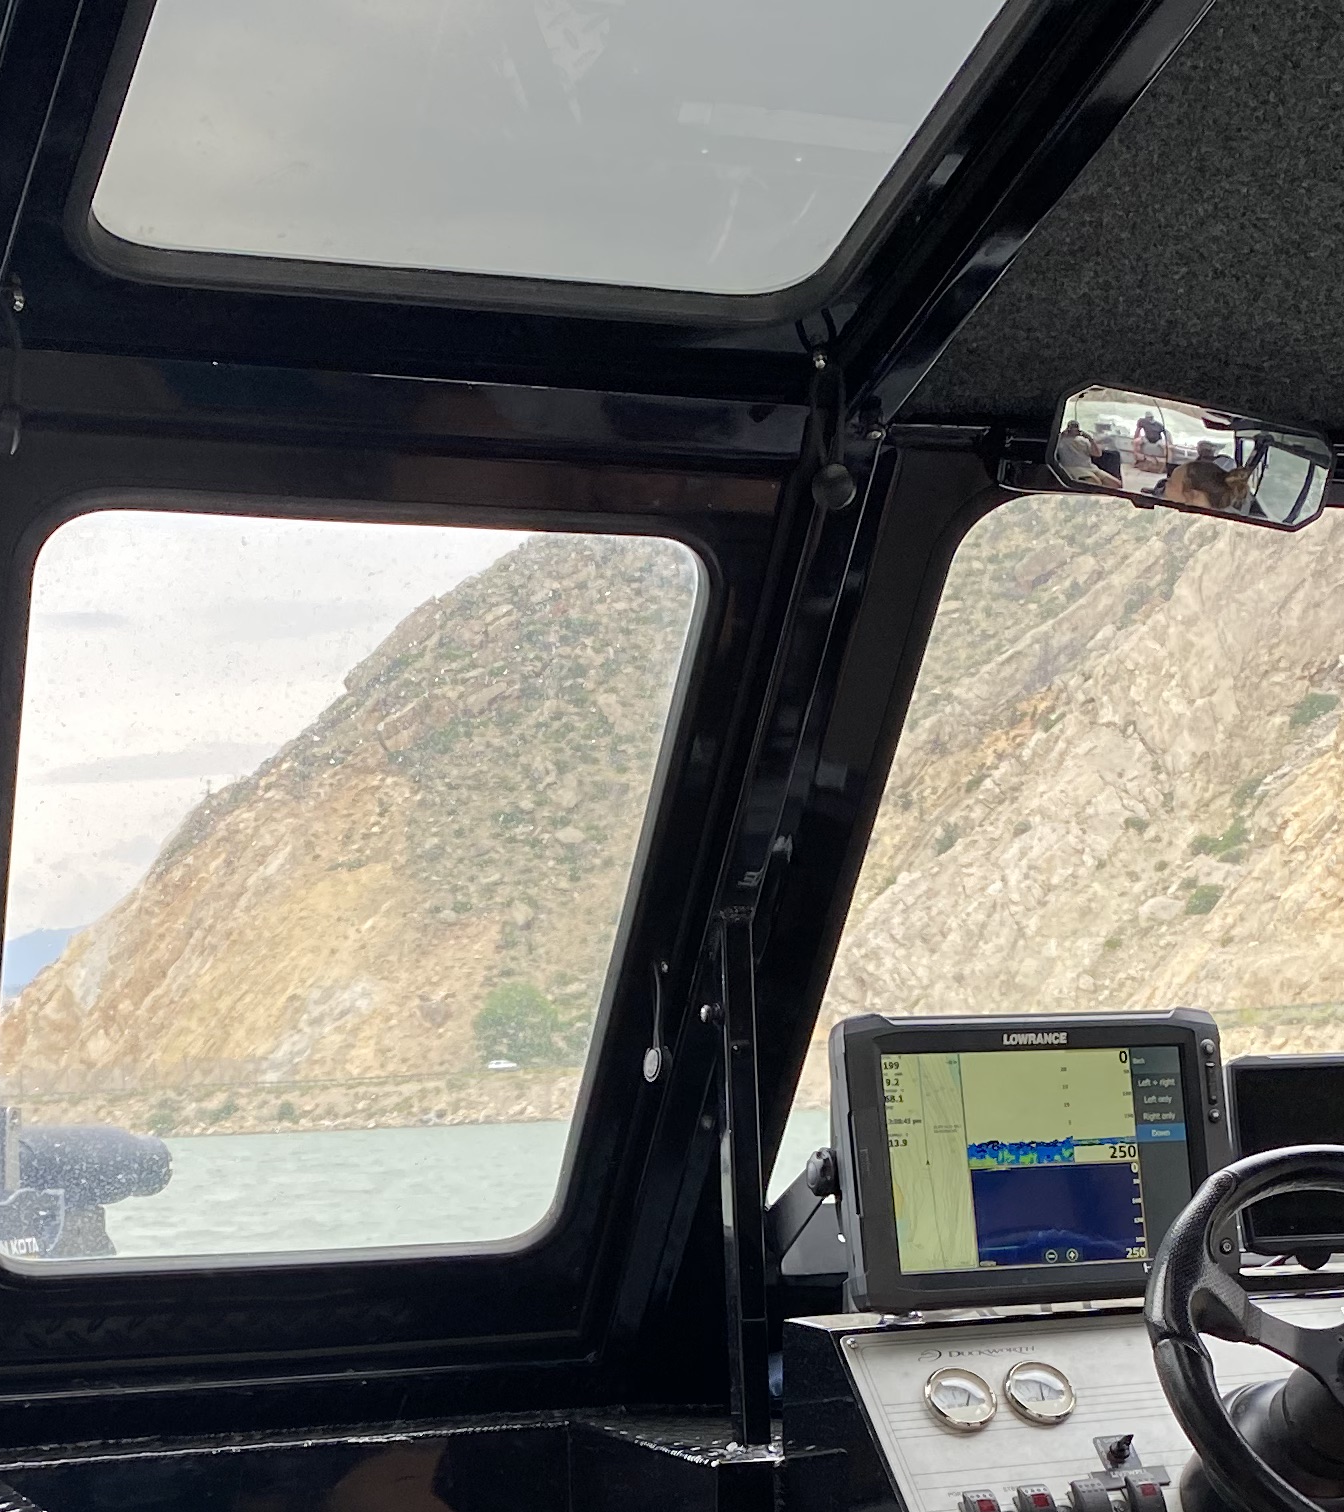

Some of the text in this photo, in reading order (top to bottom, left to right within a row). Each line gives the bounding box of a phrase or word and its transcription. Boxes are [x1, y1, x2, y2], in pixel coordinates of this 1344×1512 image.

[1003, 1032, 1067, 1045] LOWRANCE
[1119, 1051, 1128, 1063] 0
[1109, 1145, 1137, 1158] 250
[1126, 1247, 1146, 1259] 250
